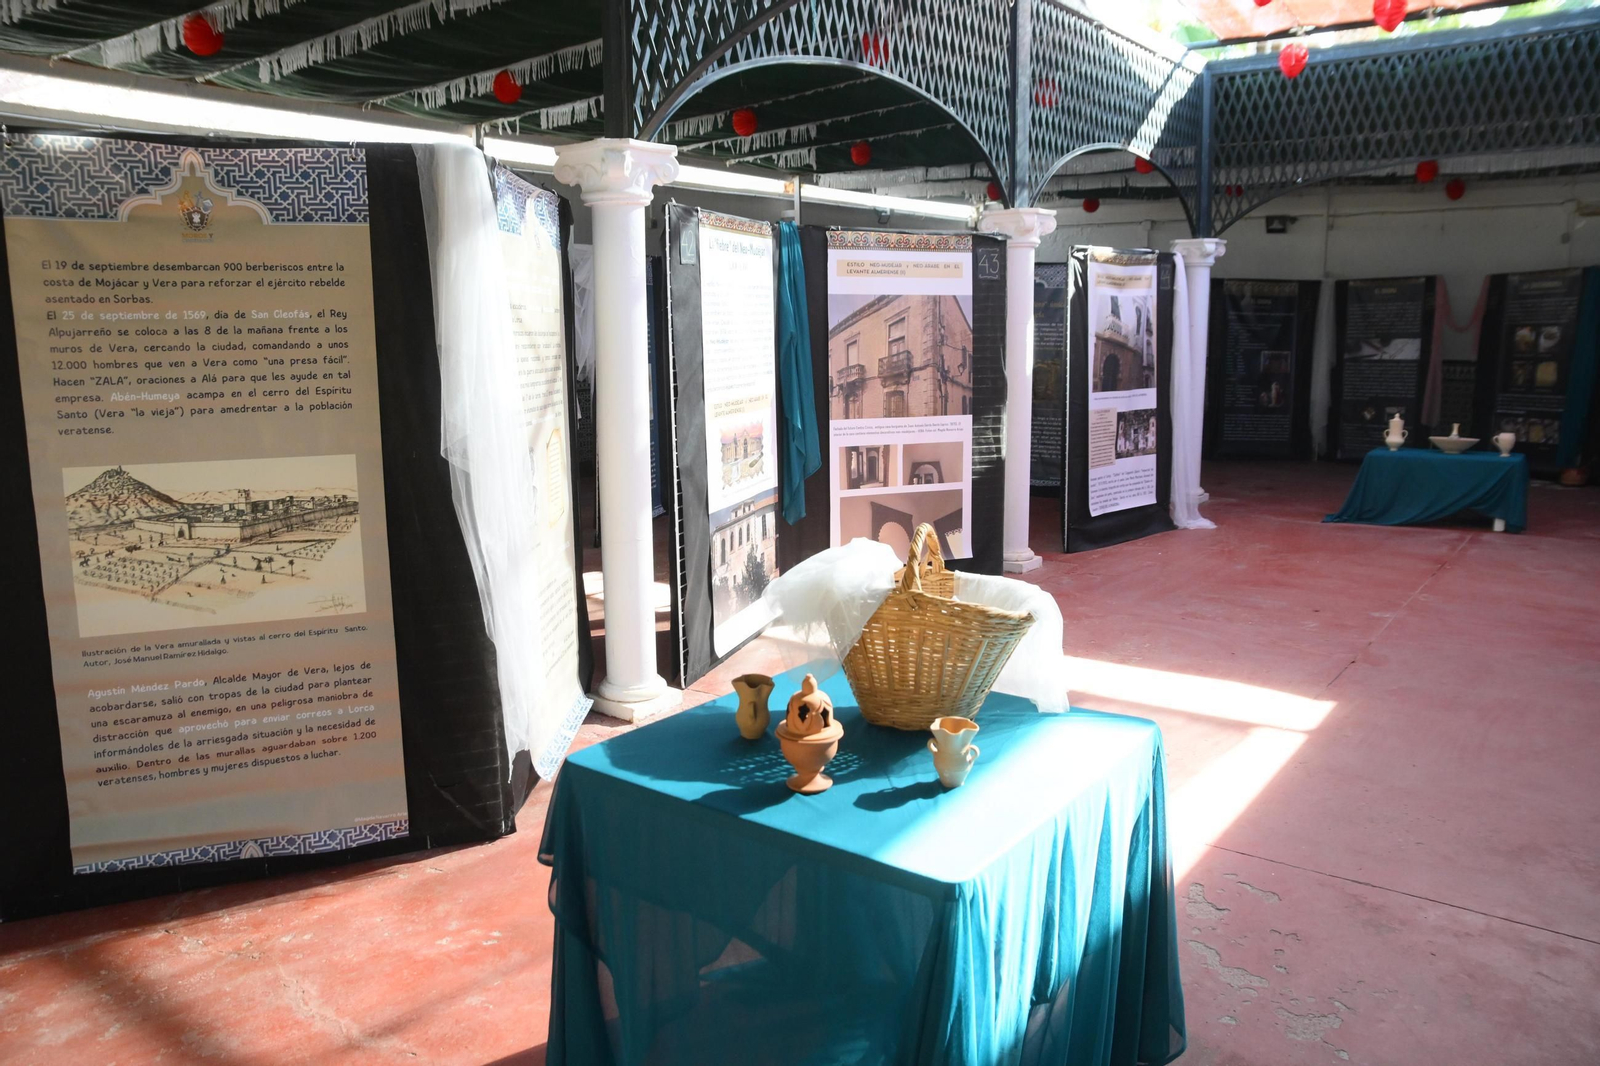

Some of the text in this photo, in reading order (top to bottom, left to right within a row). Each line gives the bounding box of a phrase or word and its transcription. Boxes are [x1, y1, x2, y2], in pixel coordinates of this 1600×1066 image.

[681, 230, 695, 256] 42
[41, 260, 51, 270] El
[55, 260, 68, 270] 19
[71, 260, 85, 270] de
[88, 262, 150, 272] septiembre
[152, 262, 221, 271] desembarcan
[223, 262, 243, 271] 900
[245, 262, 304, 272] berberiscos
[335, 262, 345, 272] la
[978, 253, 999, 274] 43
[78, 277, 92, 287] de
[95, 278, 140, 290] Mojácar
[143, 281, 149, 290] y
[152, 278, 178, 288] Vera
[180, 280, 206, 289] para
[208, 278, 253, 288] reforzar
[255, 278, 265, 287] el
[267, 278, 307, 290] ejército
[309, 278, 346, 287] rebelde
[46, 311, 57, 320] El
[62, 310, 75, 320] 25
[80, 310, 94, 320] de
[99, 311, 160, 321] septiembre
[164, 310, 178, 320] de
[183, 310, 209, 320] 1569,
[233, 310, 247, 319] de
[251, 310, 269, 319] San
[273, 309, 313, 319] Cleofás,
[316, 309, 326, 318] el
[329, 309, 348, 320] Rey
[89, 343, 103, 353] de
[108, 344, 138, 353] Vera,
[143, 342, 191, 352] cercando
[196, 342, 206, 351] la
[211, 341, 247, 351] ciudad,
[252, 340, 311, 350] comandando
[52, 360, 87, 370] 12.000
[92, 360, 139, 369] hombres
[144, 361, 163, 370] que
[202, 358, 228, 367] Vera
[289, 358, 318, 367] presa
[54, 395, 104, 405] empresa.
[110, 392, 180, 402] Abén-Humeya
[186, 391, 225, 400] acampa
[248, 388, 257, 398] el
[295, 386, 310, 396] del
[315, 386, 352, 396] Espíritu
[81, 647, 127, 657] Ilustración
[177, 638, 222, 648] amurallada
[132, 654, 163, 662] Manuel
[162, 652, 197, 660] Ramírez
[87, 687, 125, 700] Agustín
[131, 683, 169, 693] Méndez
[174, 679, 208, 689] Pardo,
[212, 674, 247, 685] Alcalde
[252, 672, 282, 682] Mayor
[287, 668, 299, 677] de
[333, 664, 355, 674] lejos
[360, 661, 371, 670] de
[89, 700, 157, 712] acobardarse,
[161, 696, 184, 706] salió
[208, 691, 242, 700] tropas
[245, 687, 258, 696] de
[261, 686, 271, 694] la
[274, 682, 304, 693] ciudad
[307, 681, 330, 691] para
[333, 678, 372, 688] plantear
[113, 714, 173, 726] escaramuza
[177, 710, 186, 719] al
[190, 707, 232, 717] enemigo,
[270, 698, 314, 709] peligrosa
[317, 692, 359, 702] maniobra
[362, 690, 374, 698] de
[92, 730, 150, 743] distracción
[154, 728, 173, 737] que
[178, 720, 229, 734] aprovechó
[234, 718, 257, 728] para
[262, 714, 290, 723] enviar
[296, 710, 332, 719] correos
[348, 705, 375, 714] Lorca
[93, 717, 376, 758] informándoles de la arriesgada situación y la necesidad de
[95, 763, 130, 773] auxilio.
[136, 758, 172, 768] Dentro
[177, 754, 190, 763] de
[195, 752, 210, 760] las
[216, 747, 256, 758] murallas
[261, 740, 316, 753] aguardaban
[321, 736, 348, 744] sobre
[97, 774, 157, 787] veratenses,
[158, 768, 201, 779] hombres
[202, 767, 209, 776] y
[210, 762, 249, 773] mujeres
[251, 755, 301, 767] dispuestos
[310, 750, 341, 759] luchar.
